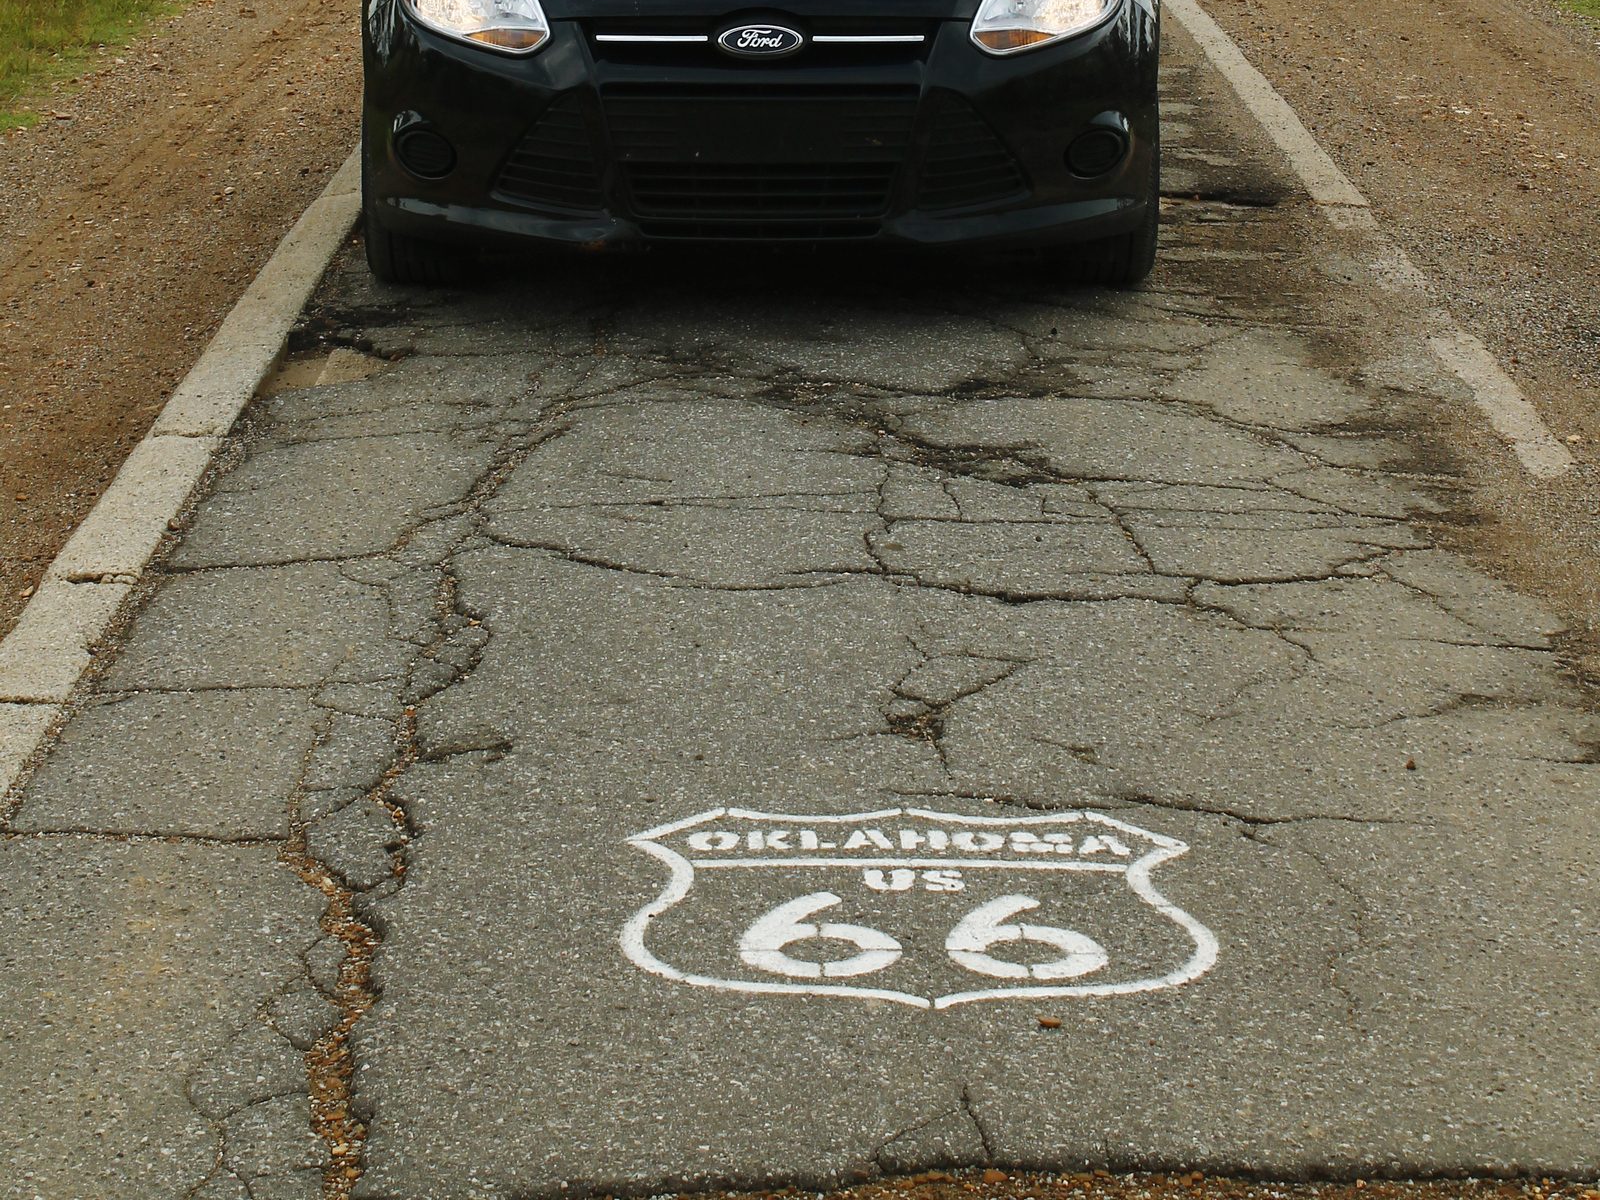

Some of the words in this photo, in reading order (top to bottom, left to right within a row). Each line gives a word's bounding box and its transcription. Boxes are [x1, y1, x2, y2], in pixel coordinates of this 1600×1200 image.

[737, 29, 783, 48] Ford
[687, 829, 1132, 857] OKLAHOMA
[863, 868, 966, 892] US
[738, 892, 1109, 979] 66
